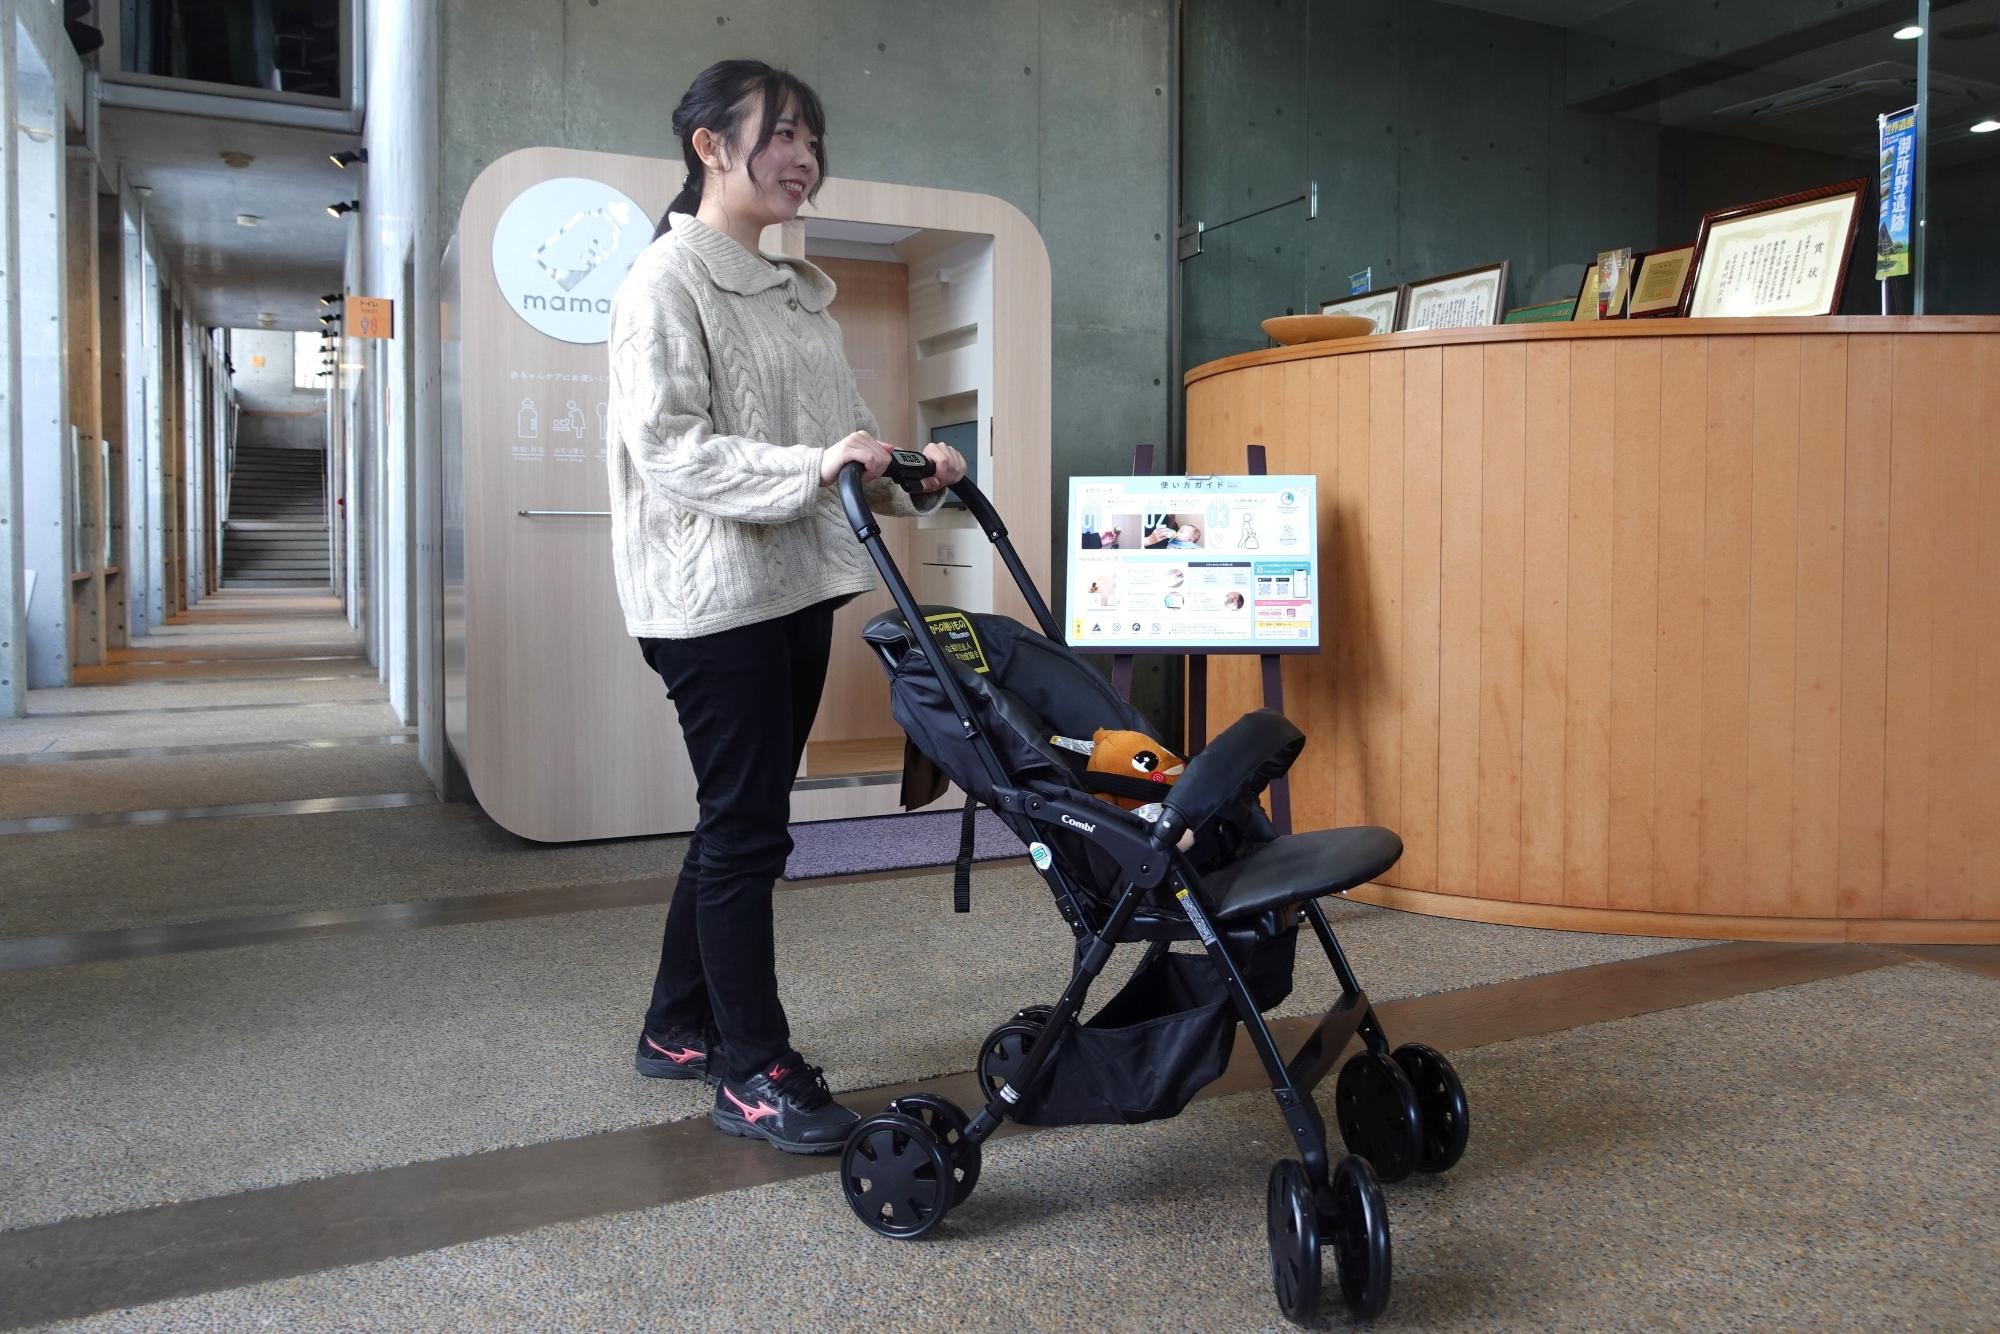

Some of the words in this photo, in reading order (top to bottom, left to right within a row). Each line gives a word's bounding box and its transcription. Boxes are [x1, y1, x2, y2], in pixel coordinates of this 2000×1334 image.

[1885, 115, 1917, 136] 世界遺産
[1890, 134, 1912, 233] 御所野遺跡
[1160, 481, 1224, 489] 使い方ガイド
[1061, 814, 1096, 833] Combi
